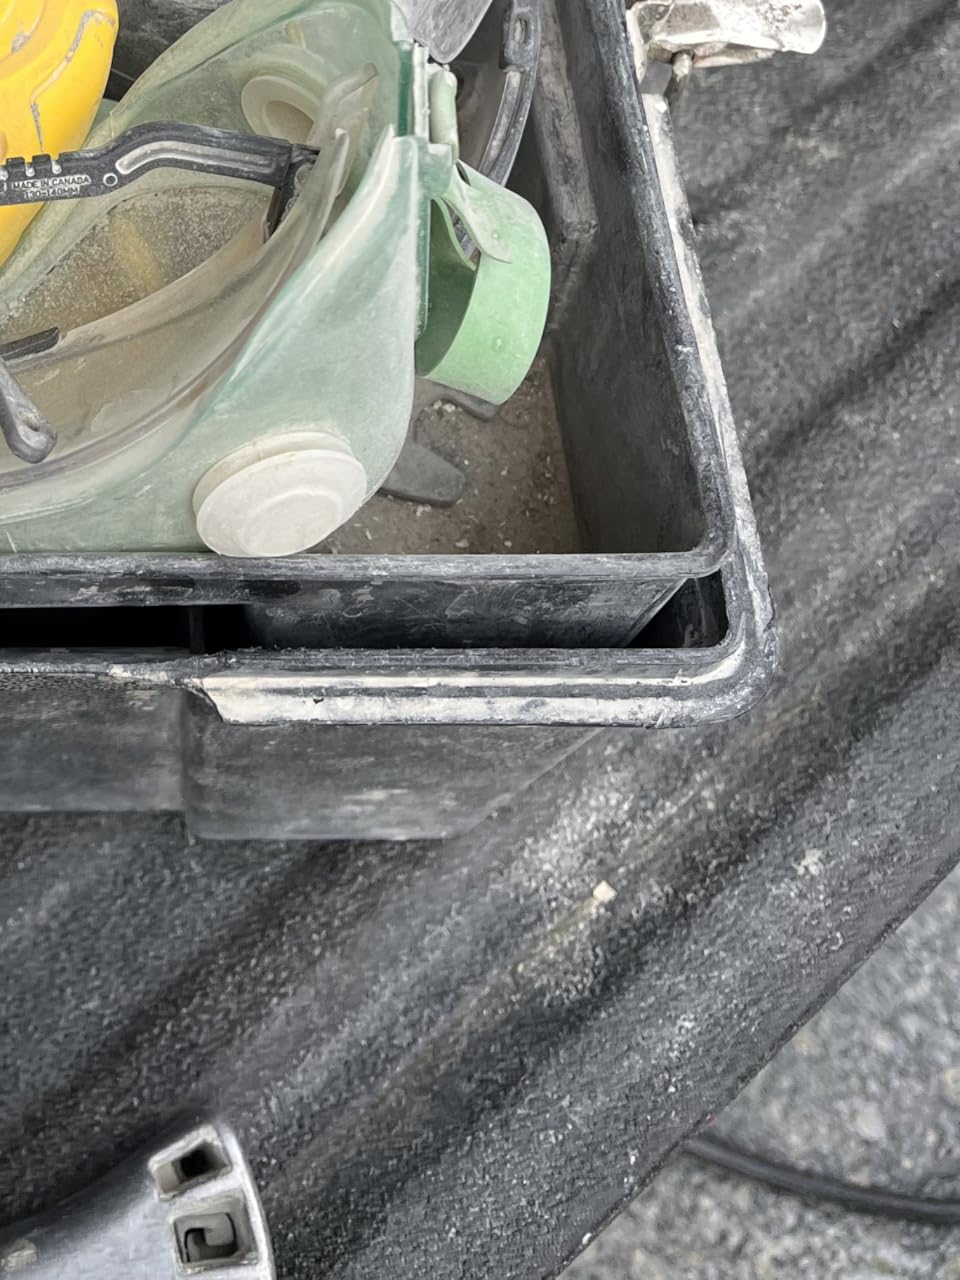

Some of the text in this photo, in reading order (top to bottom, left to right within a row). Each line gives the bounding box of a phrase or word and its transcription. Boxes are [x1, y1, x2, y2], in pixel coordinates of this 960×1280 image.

[13, 175, 91, 190] MADE IN CANADA
